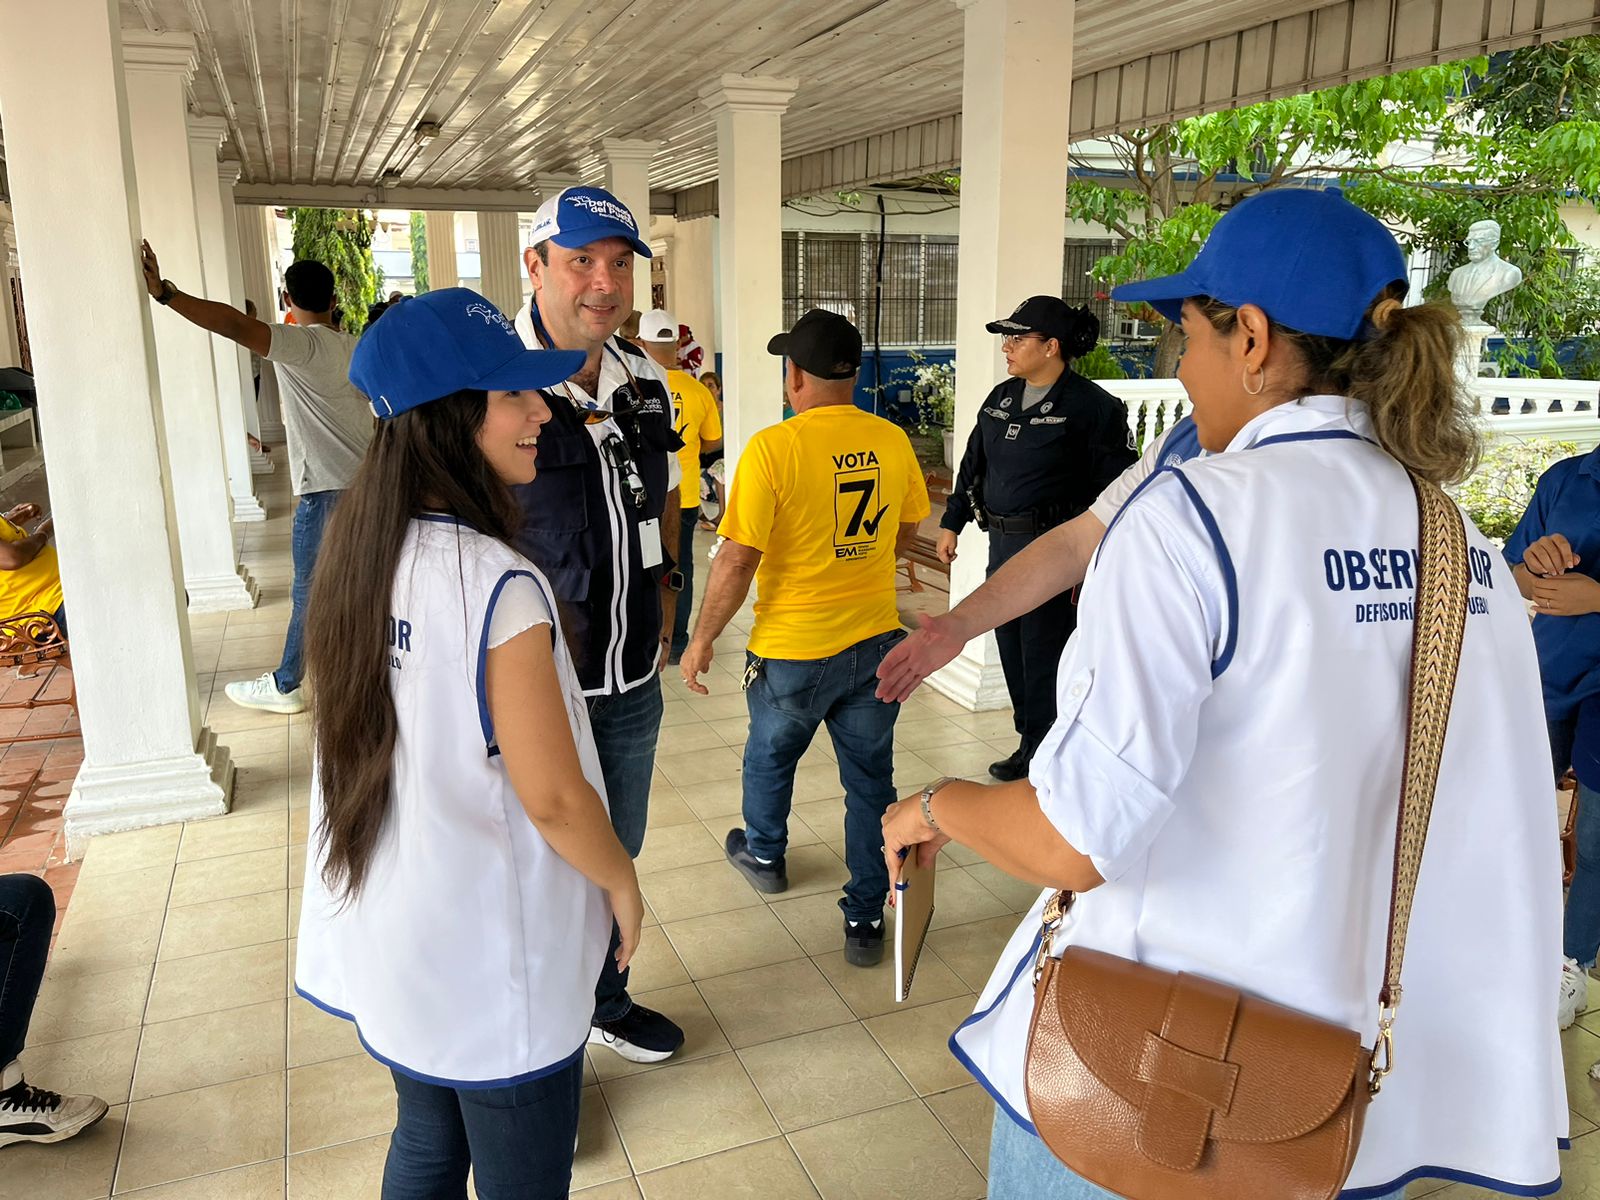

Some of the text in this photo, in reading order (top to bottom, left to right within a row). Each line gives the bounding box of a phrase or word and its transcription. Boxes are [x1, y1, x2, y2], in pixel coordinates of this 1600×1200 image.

[671, 392, 682, 400] TA
[832, 451, 879, 469] VOTA
[839, 479, 875, 537] 7
[835, 547, 857, 558] EM
[1323, 547, 1494, 591] OBSEROR
